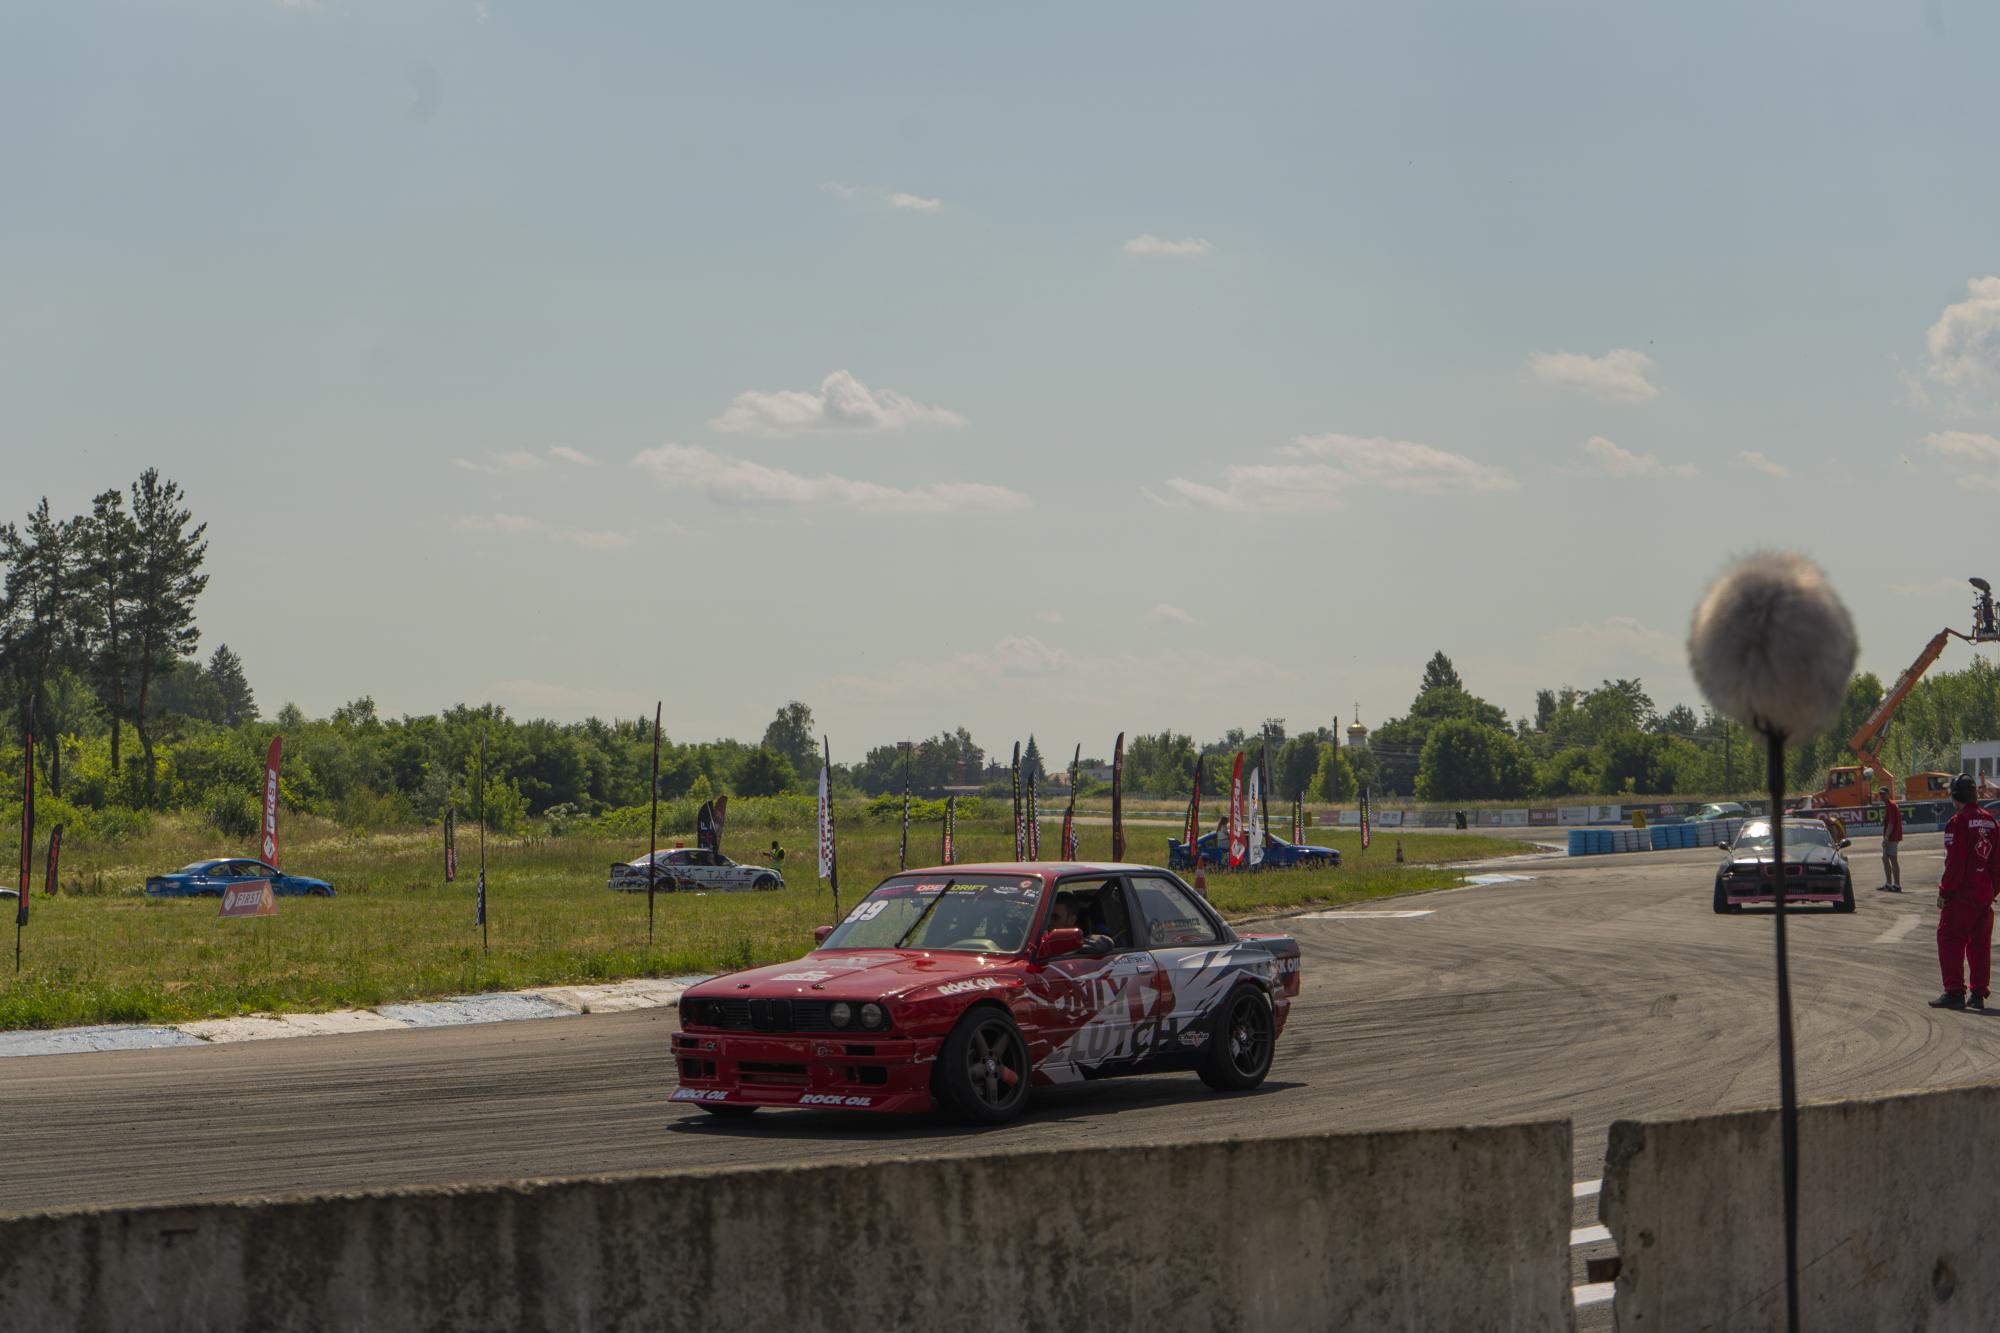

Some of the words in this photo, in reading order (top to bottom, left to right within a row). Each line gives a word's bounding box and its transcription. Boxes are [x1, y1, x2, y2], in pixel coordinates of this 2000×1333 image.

[1233, 780, 1241, 834] FIRST
[951, 884, 989, 892] DRIFT
[237, 891, 260, 905] FIRST
[845, 900, 888, 924] 99
[937, 978, 977, 996] ROCK
[977, 976, 1002, 989] OIL
[674, 1088, 707, 1099] ROCK
[707, 1090, 729, 1100] OIL
[799, 1094, 845, 1105] ROCK
[846, 1096, 871, 1106] OIL
